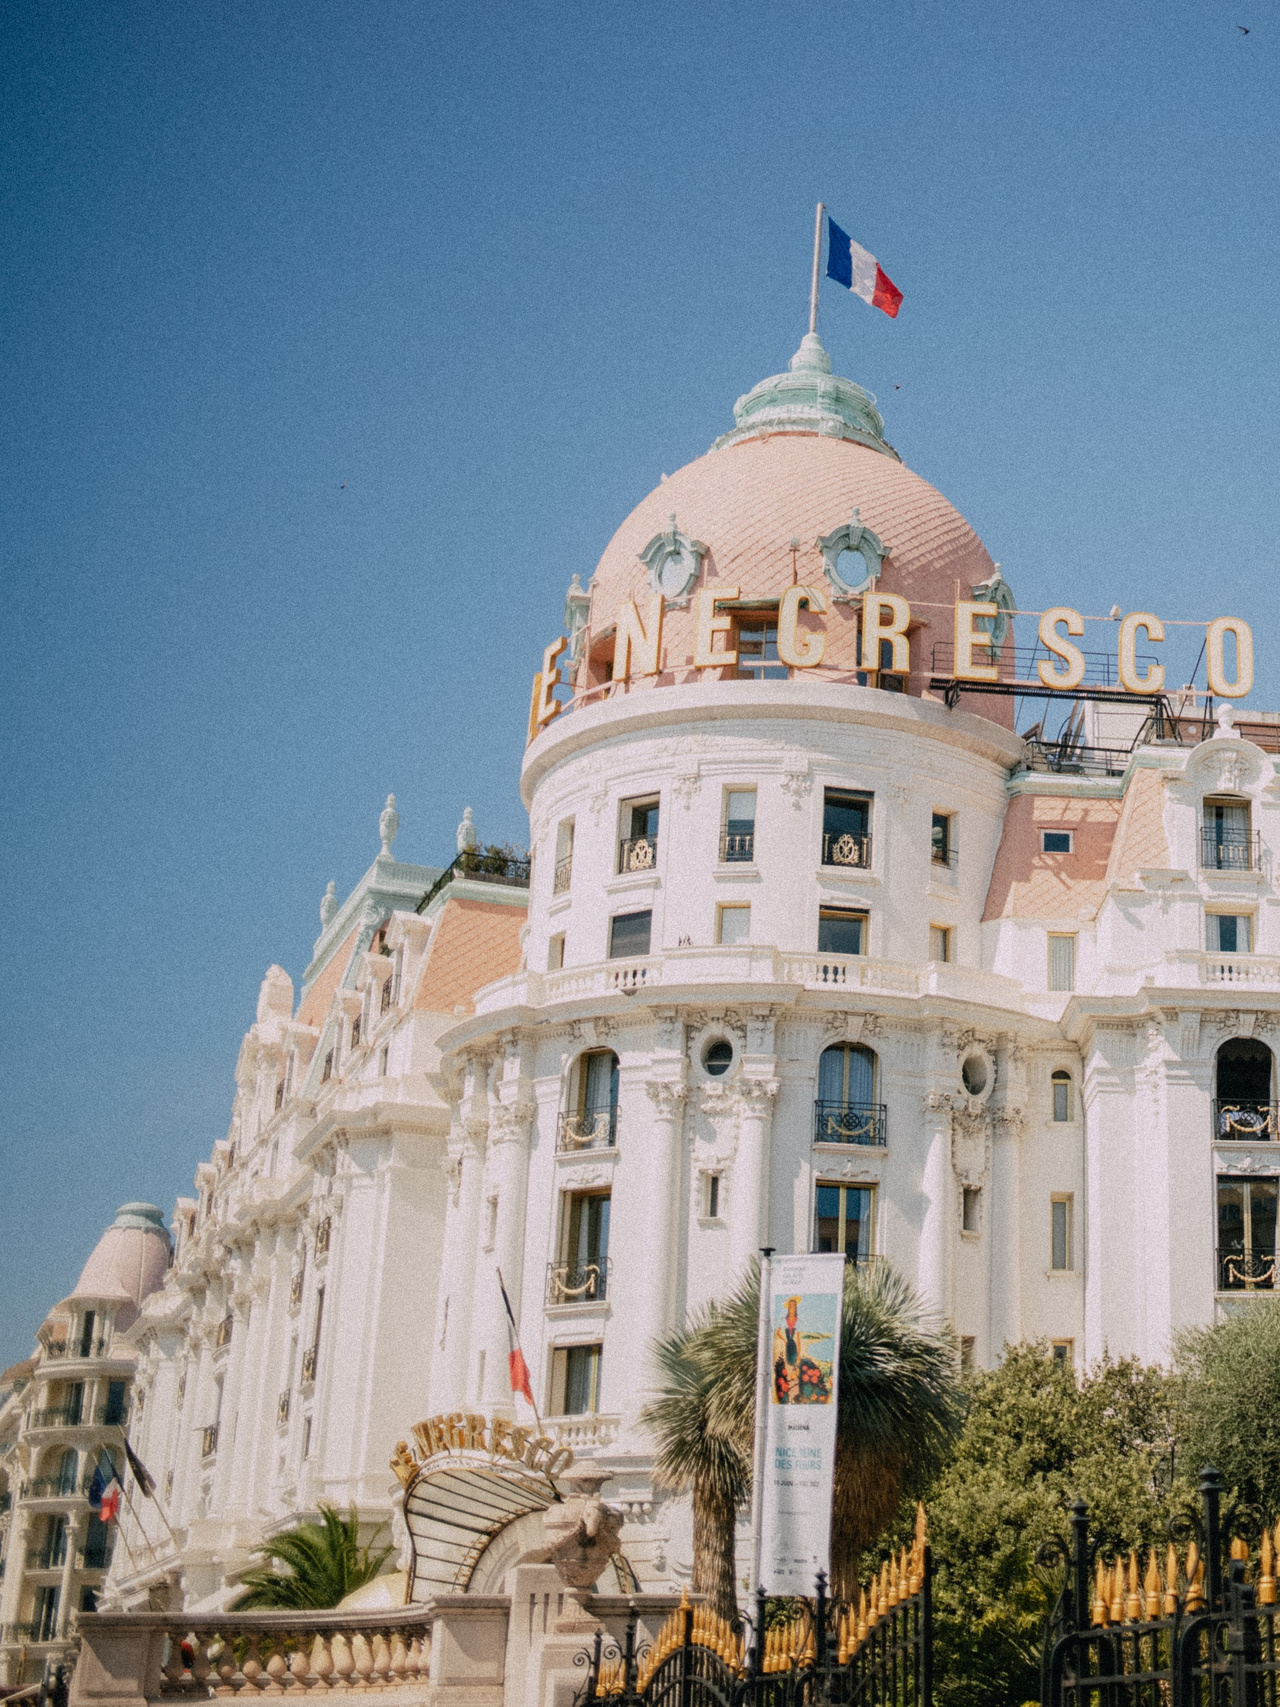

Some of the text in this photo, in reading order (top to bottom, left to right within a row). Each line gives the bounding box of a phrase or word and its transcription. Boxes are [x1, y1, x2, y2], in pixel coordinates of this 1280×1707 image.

[612, 585, 1255, 698] NEGRESCO
[410, 1412, 574, 1481] NEGRESCO
[775, 1447, 797, 1458] NICE
[775, 1459, 793, 1470] DES
